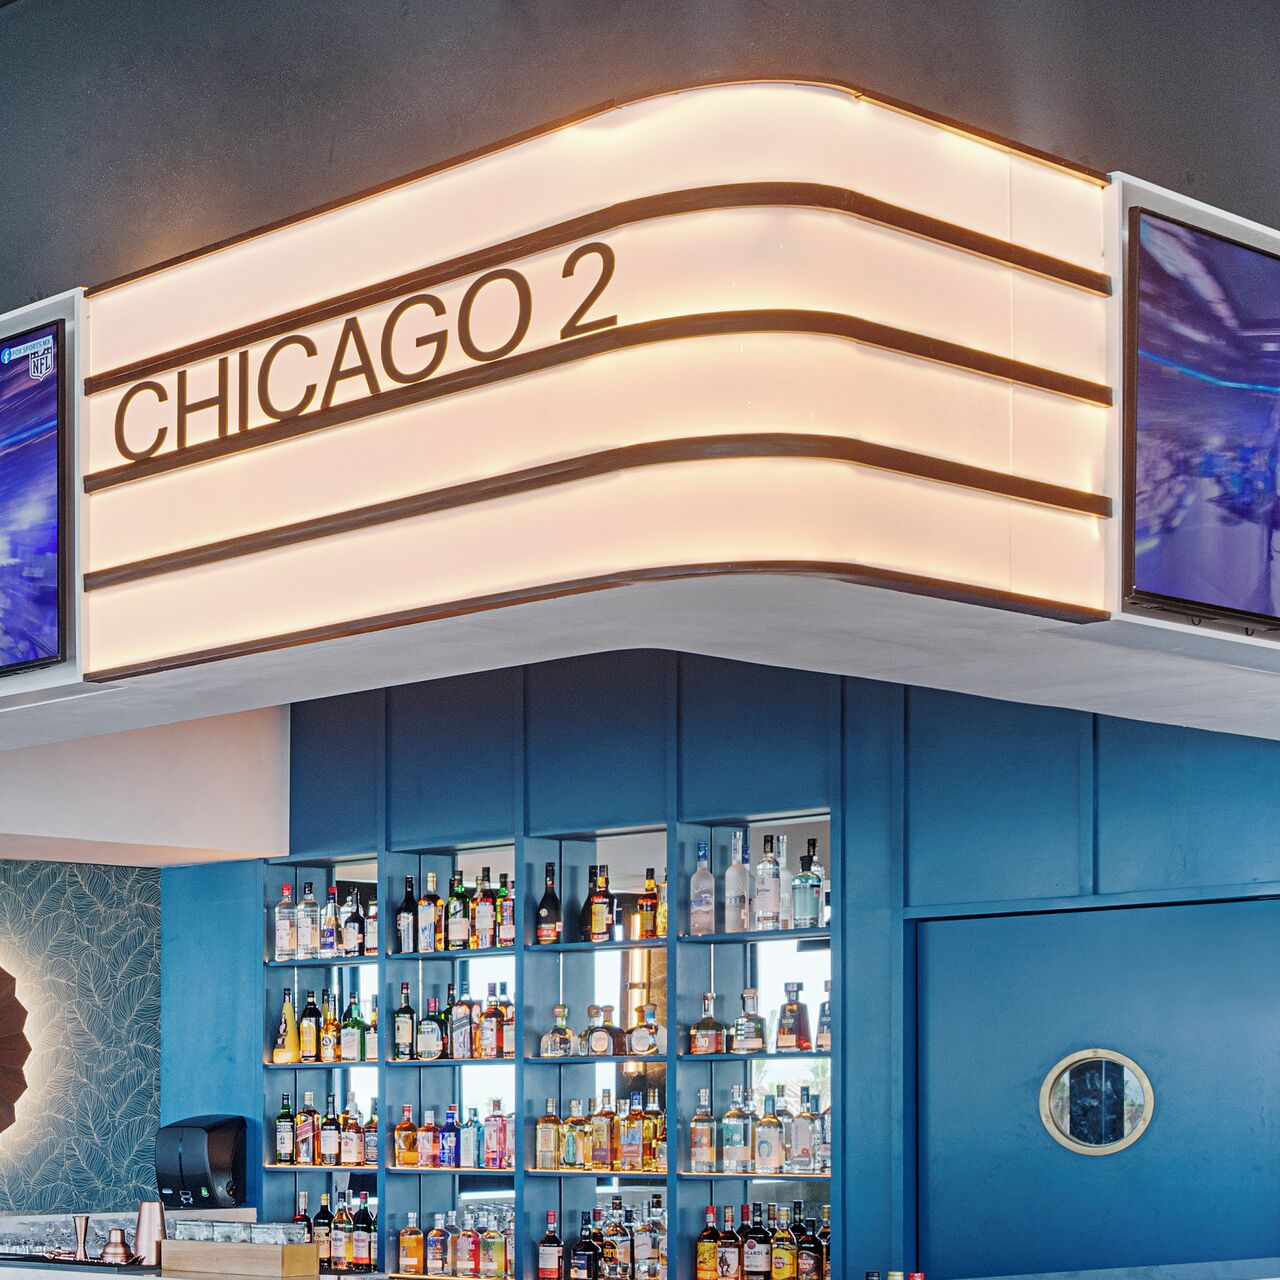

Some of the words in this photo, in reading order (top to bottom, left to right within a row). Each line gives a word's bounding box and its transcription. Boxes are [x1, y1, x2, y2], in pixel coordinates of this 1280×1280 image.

[22, 343, 42, 353] SPORTS
[114, 267, 533, 462] CHICAGO
[559, 241, 618, 341] 2
[32, 356, 51, 375] NFL
